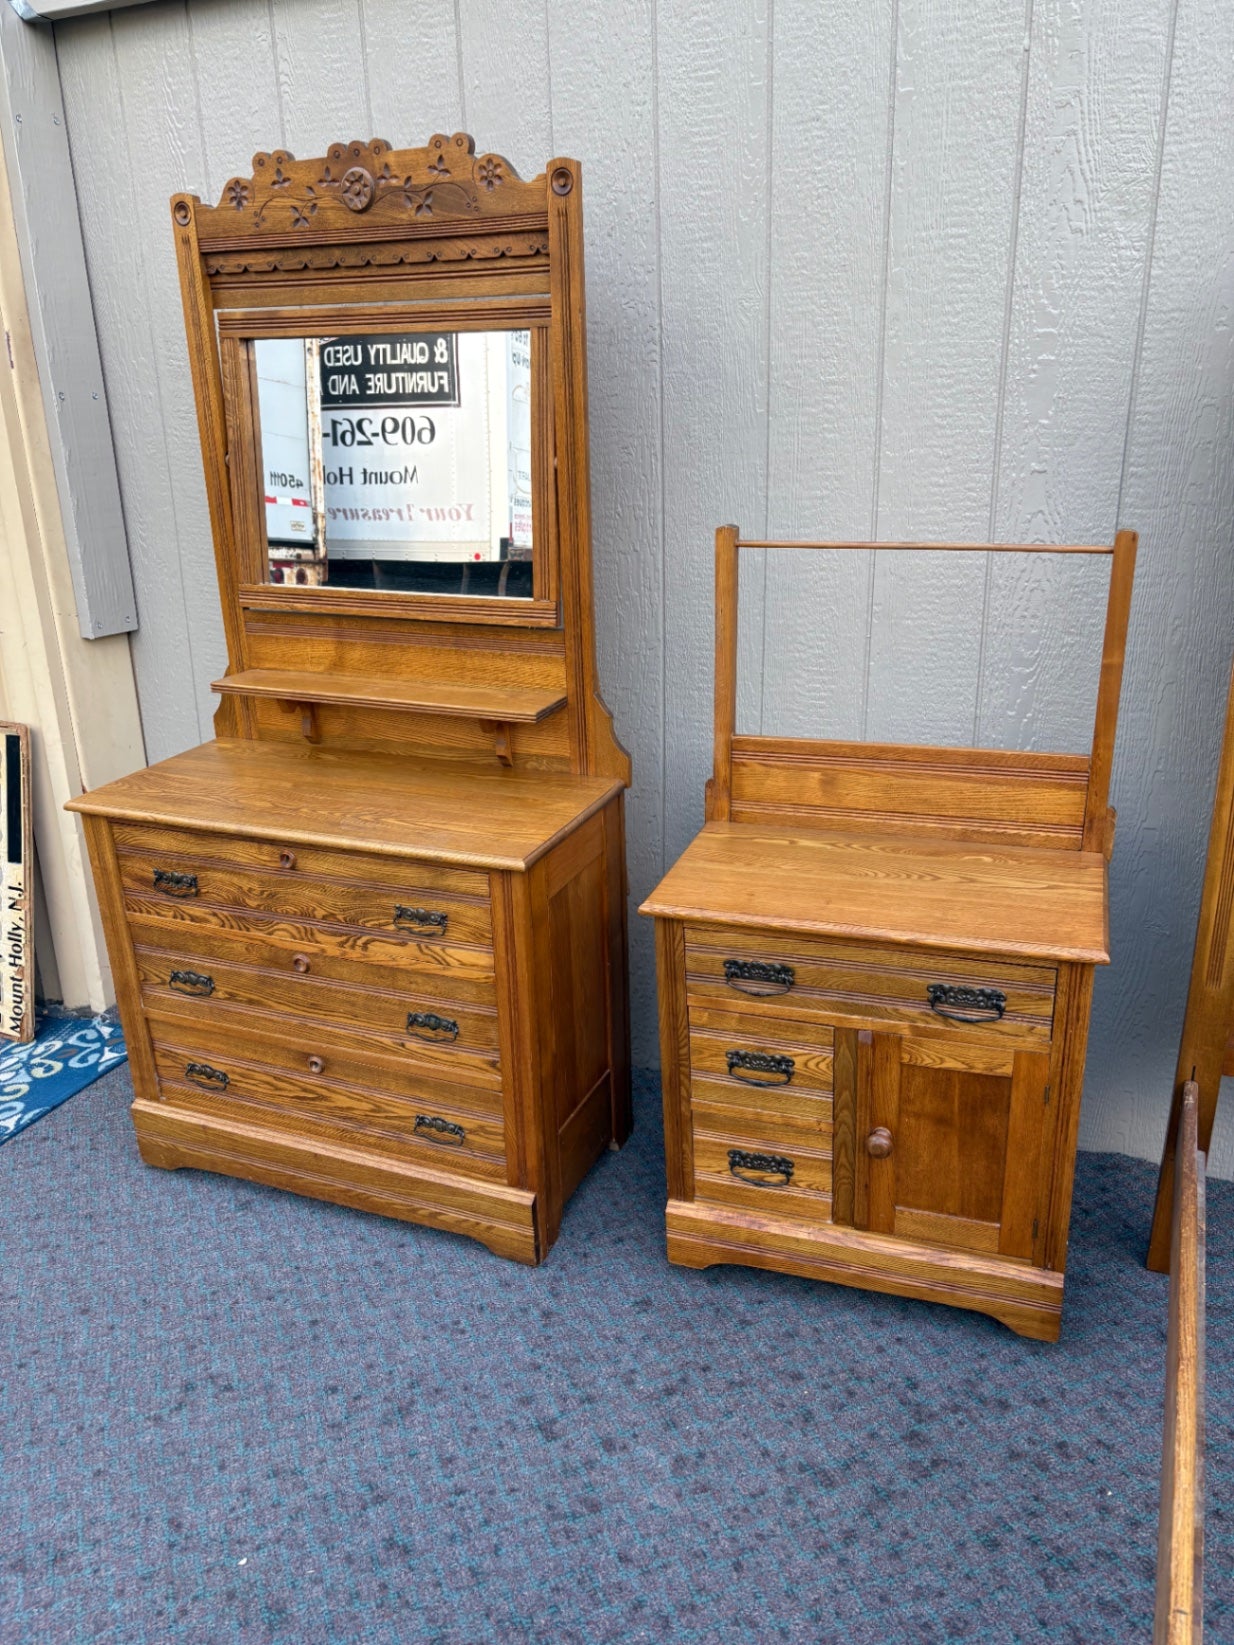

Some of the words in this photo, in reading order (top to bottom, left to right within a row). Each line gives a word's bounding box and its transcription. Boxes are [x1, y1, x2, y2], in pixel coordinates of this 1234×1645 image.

[7, 881, 25, 913] N.J.
[7, 917, 25, 968] Holly,
[9, 975, 24, 1037] Mount
